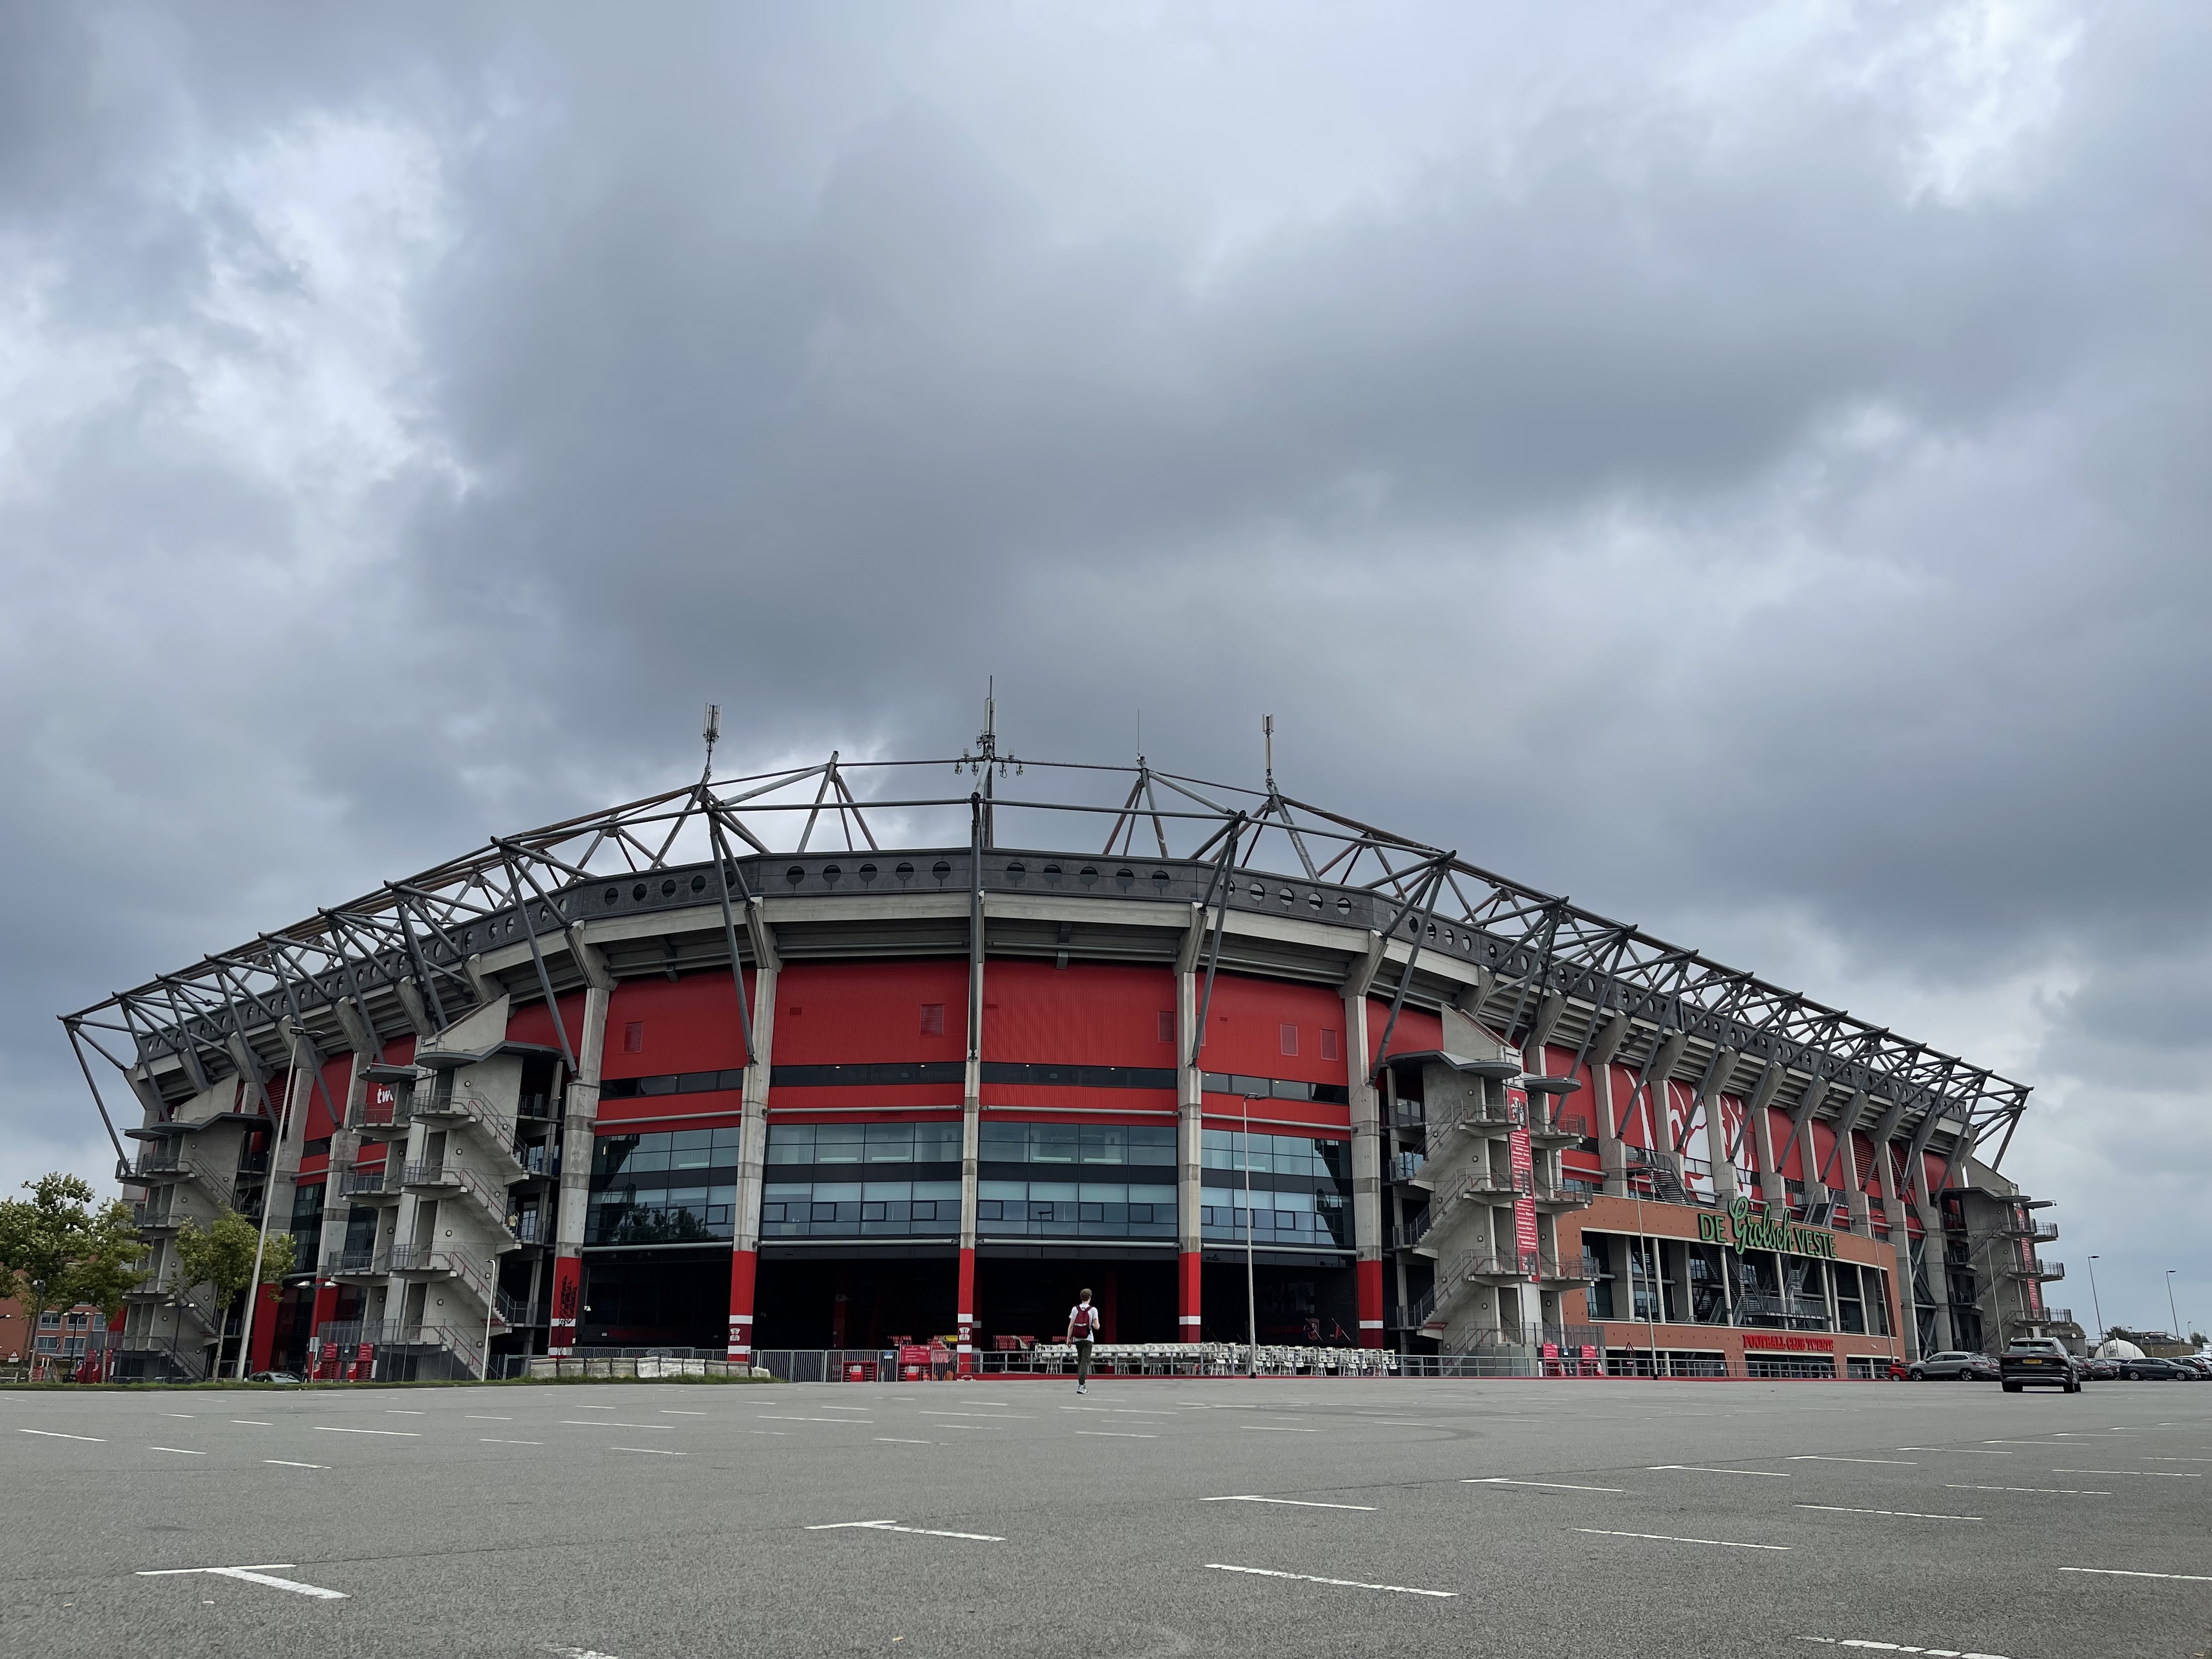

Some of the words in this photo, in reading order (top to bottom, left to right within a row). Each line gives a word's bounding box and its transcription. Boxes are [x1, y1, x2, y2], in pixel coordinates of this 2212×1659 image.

[1699, 1213, 1727, 1243] DE
[1728, 1196, 1794, 1255] Grolsch
[1793, 1227, 1838, 1259] VESTE
[1743, 1334, 1786, 1349] FOOTBALL
[1786, 1336, 1805, 1350] CLUB
[1805, 1338, 1833, 1352] TWENTE
